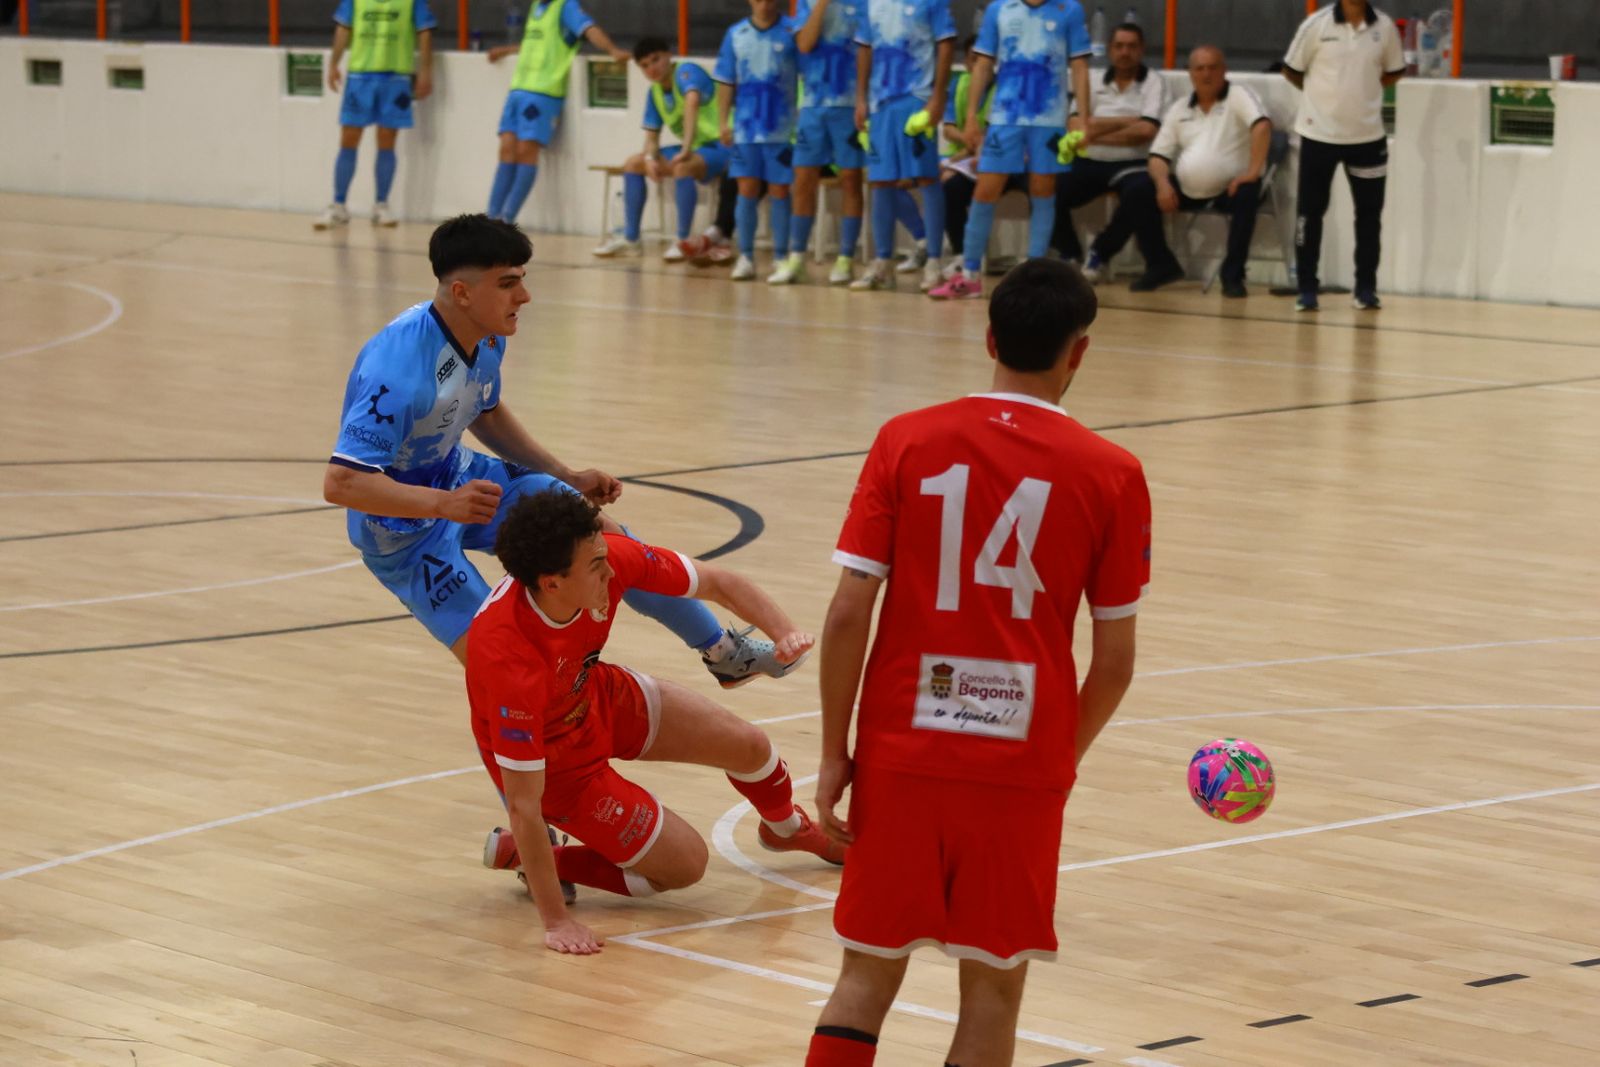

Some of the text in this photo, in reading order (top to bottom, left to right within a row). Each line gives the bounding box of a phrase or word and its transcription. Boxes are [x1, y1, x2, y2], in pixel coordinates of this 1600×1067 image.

[919, 463, 1052, 620] 14
[430, 571, 467, 611] ACTIO
[959, 672, 1022, 687] Concello de
[959, 683, 1024, 701] Begonte
